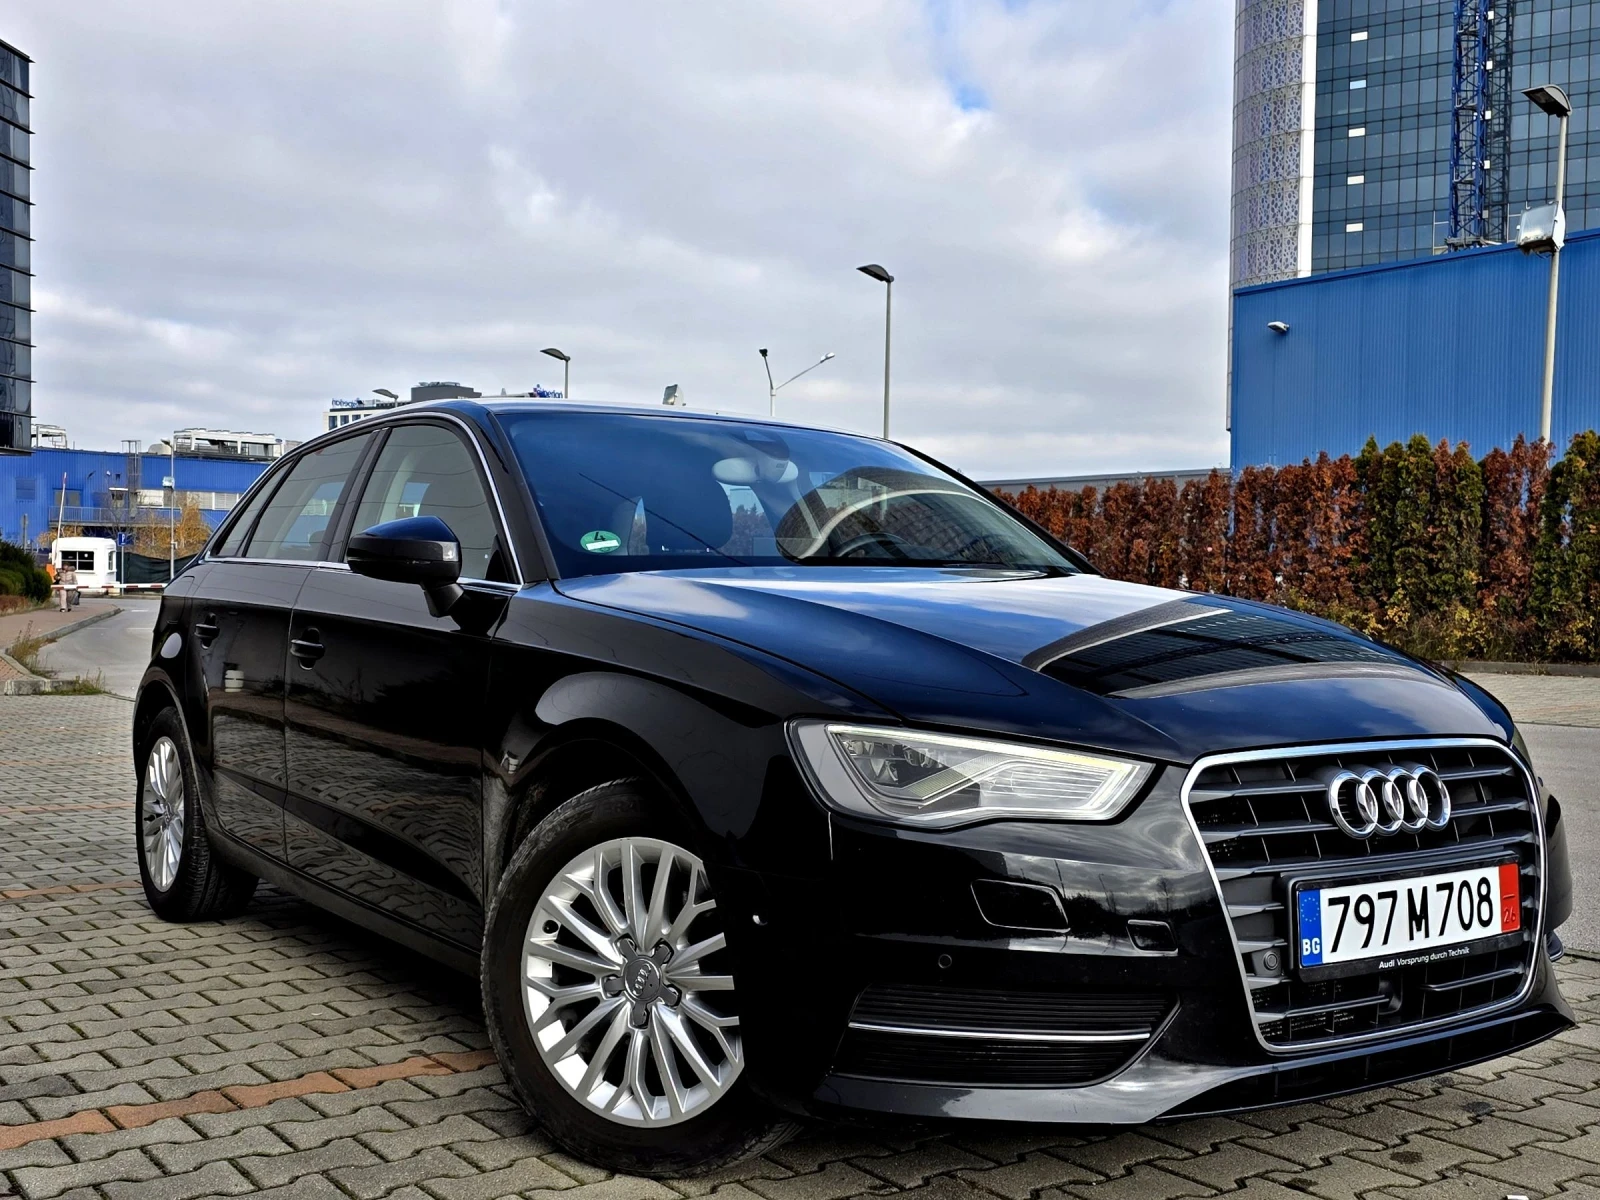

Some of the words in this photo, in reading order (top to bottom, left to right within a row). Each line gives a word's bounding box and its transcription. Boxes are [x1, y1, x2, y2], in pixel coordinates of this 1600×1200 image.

[1328, 894, 1398, 953] 797
[1436, 877, 1493, 936] 708
[1302, 938, 1320, 956] BG
[1379, 960, 1395, 969] Audi
[1397, 955, 1430, 966] Vorsprung
[1430, 953, 1448, 961] durch
[1448, 947, 1470, 957] Technik
